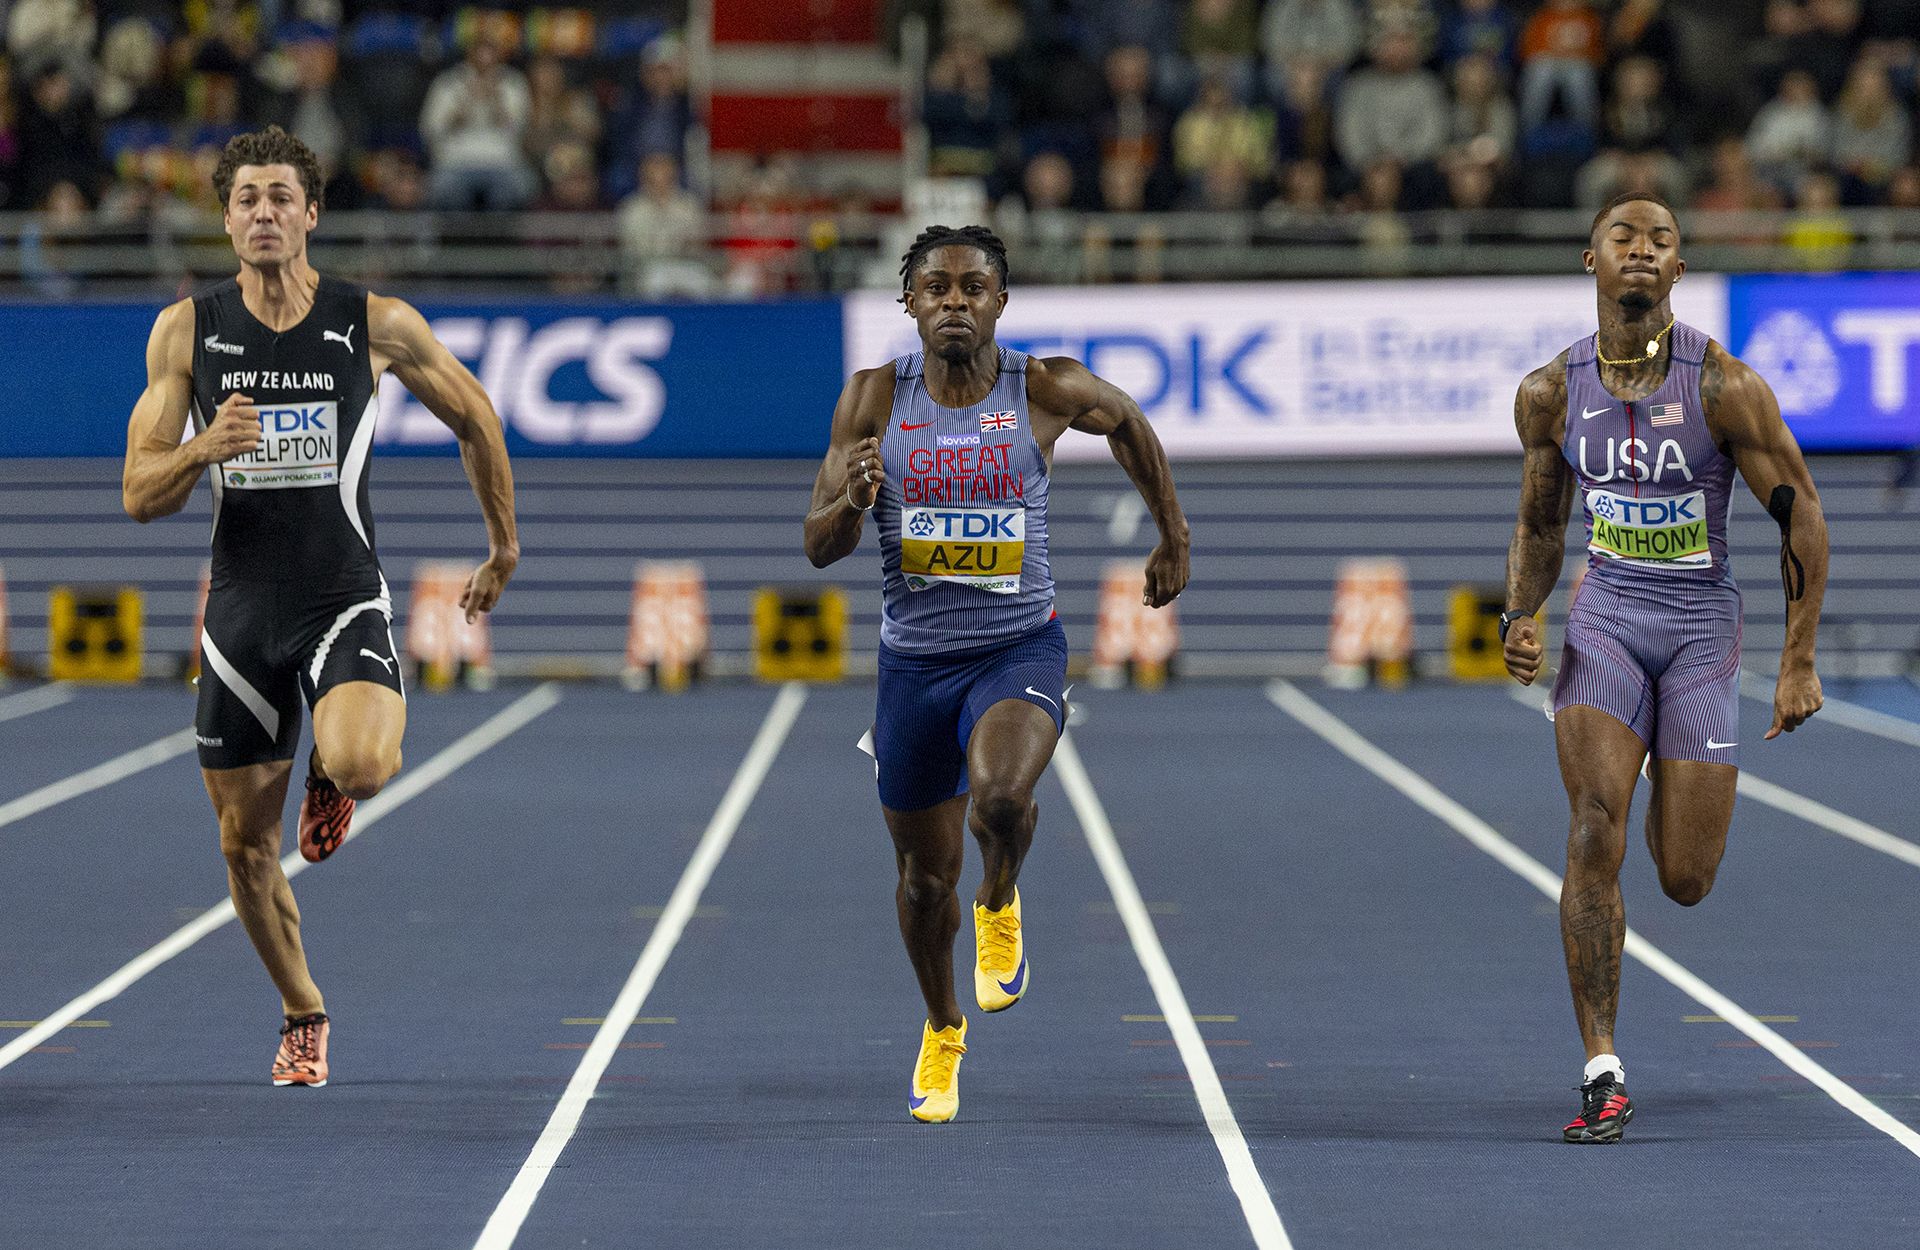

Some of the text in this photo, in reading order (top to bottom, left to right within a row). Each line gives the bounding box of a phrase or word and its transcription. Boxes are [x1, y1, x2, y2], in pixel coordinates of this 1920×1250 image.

[222, 371, 334, 391] NEW ZEALAND
[939, 435, 980, 446] Novuna
[908, 444, 1013, 475] GREAT
[1579, 436, 1693, 484] USA
[252, 475, 283, 483] KUJAWY
[285, 473, 321, 482] POMORZE
[903, 472, 1024, 503] BRITAIN
[1615, 496, 1697, 525] TDK
[934, 513, 1016, 538] TDK
[1597, 520, 1701, 555] ANTHONY
[927, 544, 998, 571] AZU
